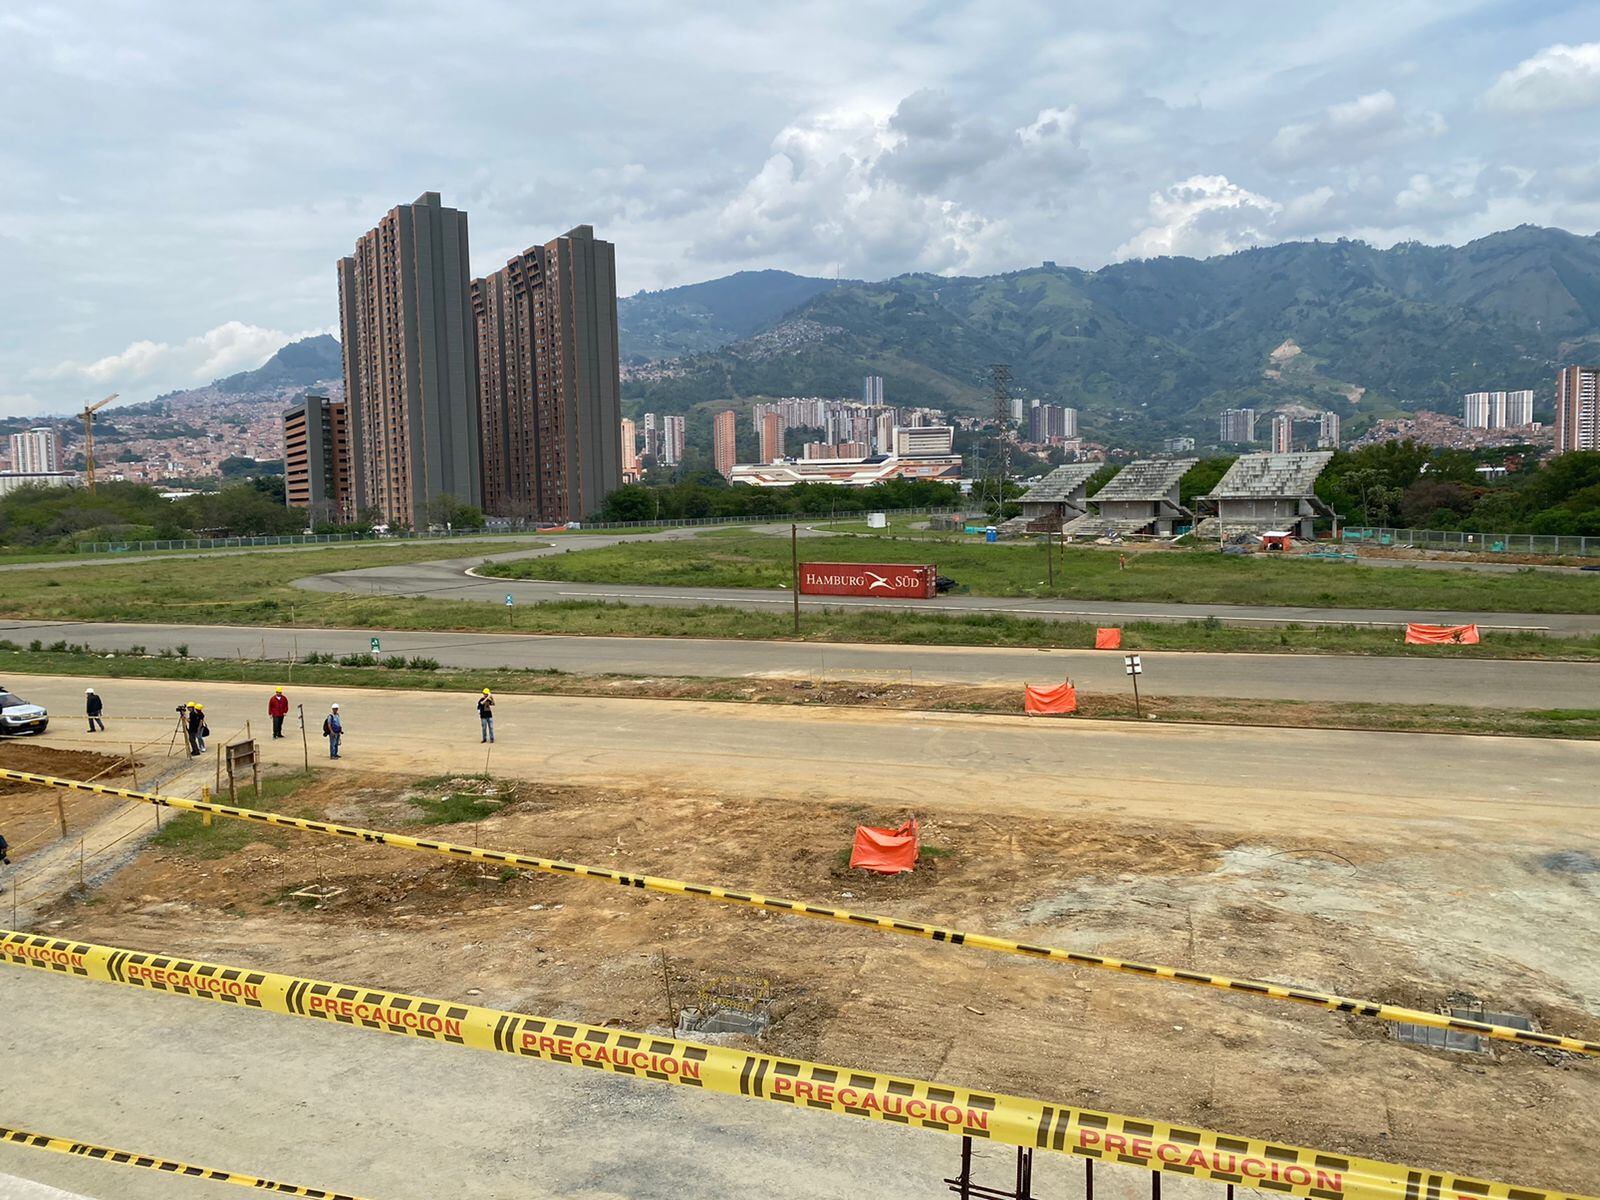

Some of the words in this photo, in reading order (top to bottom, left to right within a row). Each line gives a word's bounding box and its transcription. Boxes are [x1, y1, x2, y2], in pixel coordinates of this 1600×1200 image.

[806, 573, 865, 586] HAMBURG
[895, 575, 920, 588] SÜD
[0, 942, 84, 967] CAUCION
[128, 965, 259, 1000] PRECAUCION
[309, 996, 463, 1037] PRECAUCION
[521, 1032, 701, 1079] PRECAUCION
[774, 1077, 989, 1132] PRECAUCION
[1079, 1128, 1344, 1193] PRECAUCION
